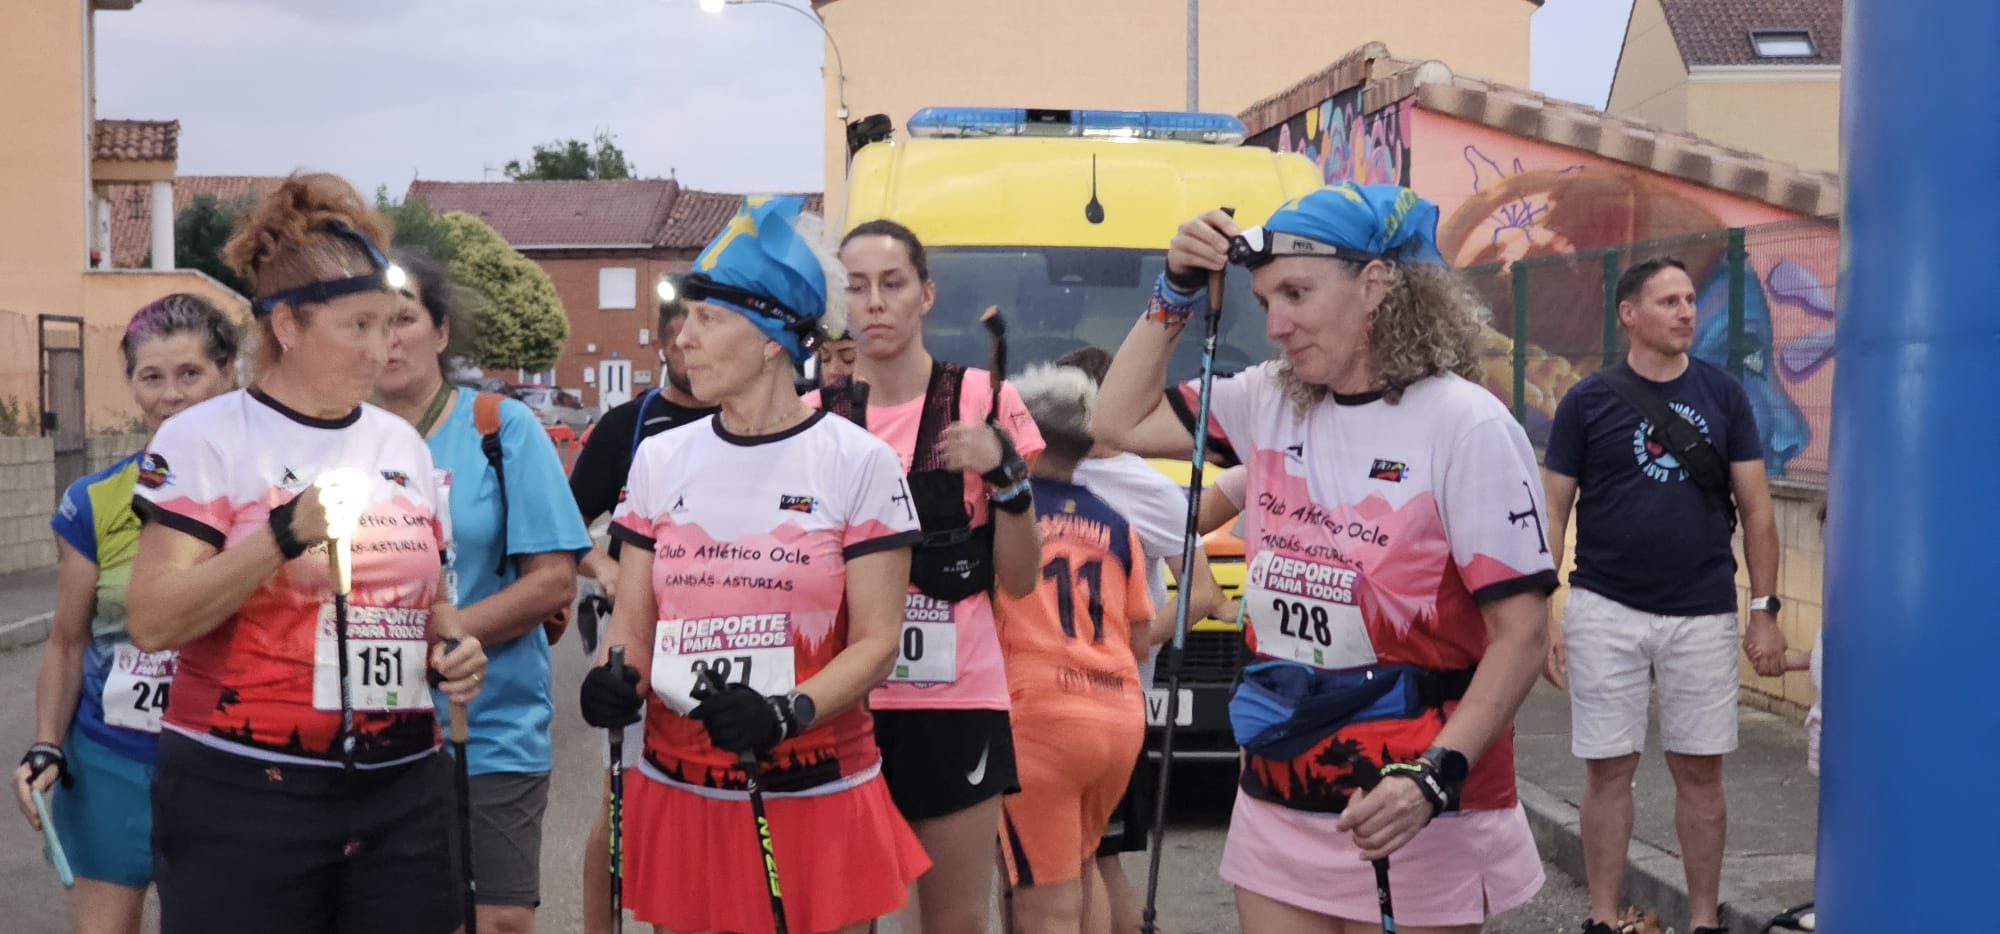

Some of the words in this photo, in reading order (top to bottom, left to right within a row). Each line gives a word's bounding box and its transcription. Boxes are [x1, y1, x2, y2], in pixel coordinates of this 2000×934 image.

[1258, 492, 1286, 515] Club
[1348, 522, 1389, 547] Ocle
[659, 544, 686, 560] Club
[694, 542, 762, 561] Atlético
[770, 547, 811, 565] Ocle
[1269, 556, 1357, 589] DEPORTE
[1043, 557, 1103, 641] 11
[1268, 574, 1303, 594] PARA
[1306, 581, 1353, 603] TODOS
[347, 606, 430, 625] DEPORTE
[682, 613, 787, 639] DEPORTE
[1273, 598, 1332, 647] 228
[346, 625, 387, 639] PARA
[388, 625, 425, 639] TODOS
[683, 634, 722, 652] PARA
[726, 631, 786, 648] TODOS
[358, 647, 403, 687] 151
